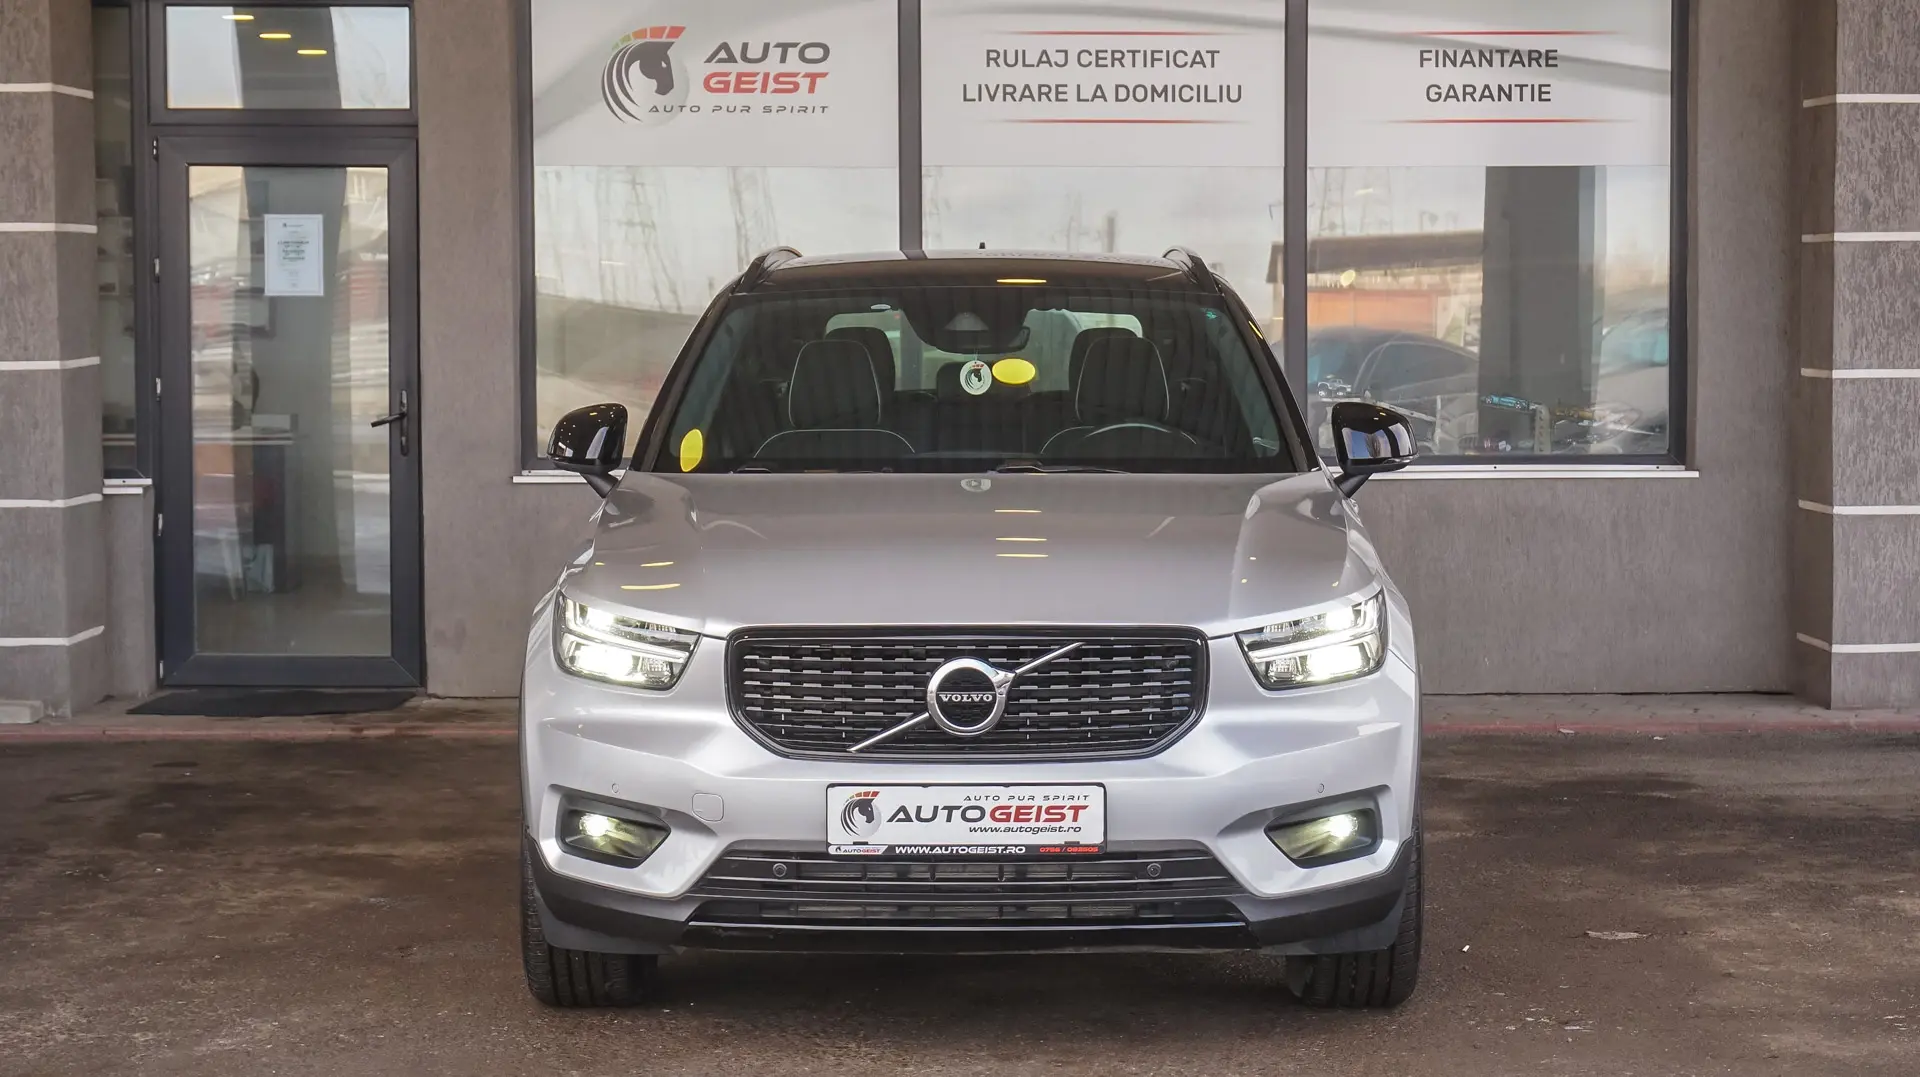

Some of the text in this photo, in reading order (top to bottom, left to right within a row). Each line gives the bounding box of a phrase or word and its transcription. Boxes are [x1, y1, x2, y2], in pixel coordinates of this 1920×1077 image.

[703, 41, 831, 64] AUTO
[985, 49, 1220, 69] RULAJ CERTIFICAT
[1419, 49, 1558, 68] FINANTARE
[702, 71, 830, 94] GEIST
[962, 83, 1242, 103] LIVRARE LA DOMICILIU
[1425, 83, 1551, 102] GARANTIE
[648, 105, 830, 113] AUTO PUR SPIRIT
[939, 694, 993, 702] VOLVO
[886, 805, 1089, 823] AUTOGEIST
[968, 825, 1082, 835] www.autogeist.ro
[895, 846, 1026, 854] WWW.AUTOGEIST.RO
